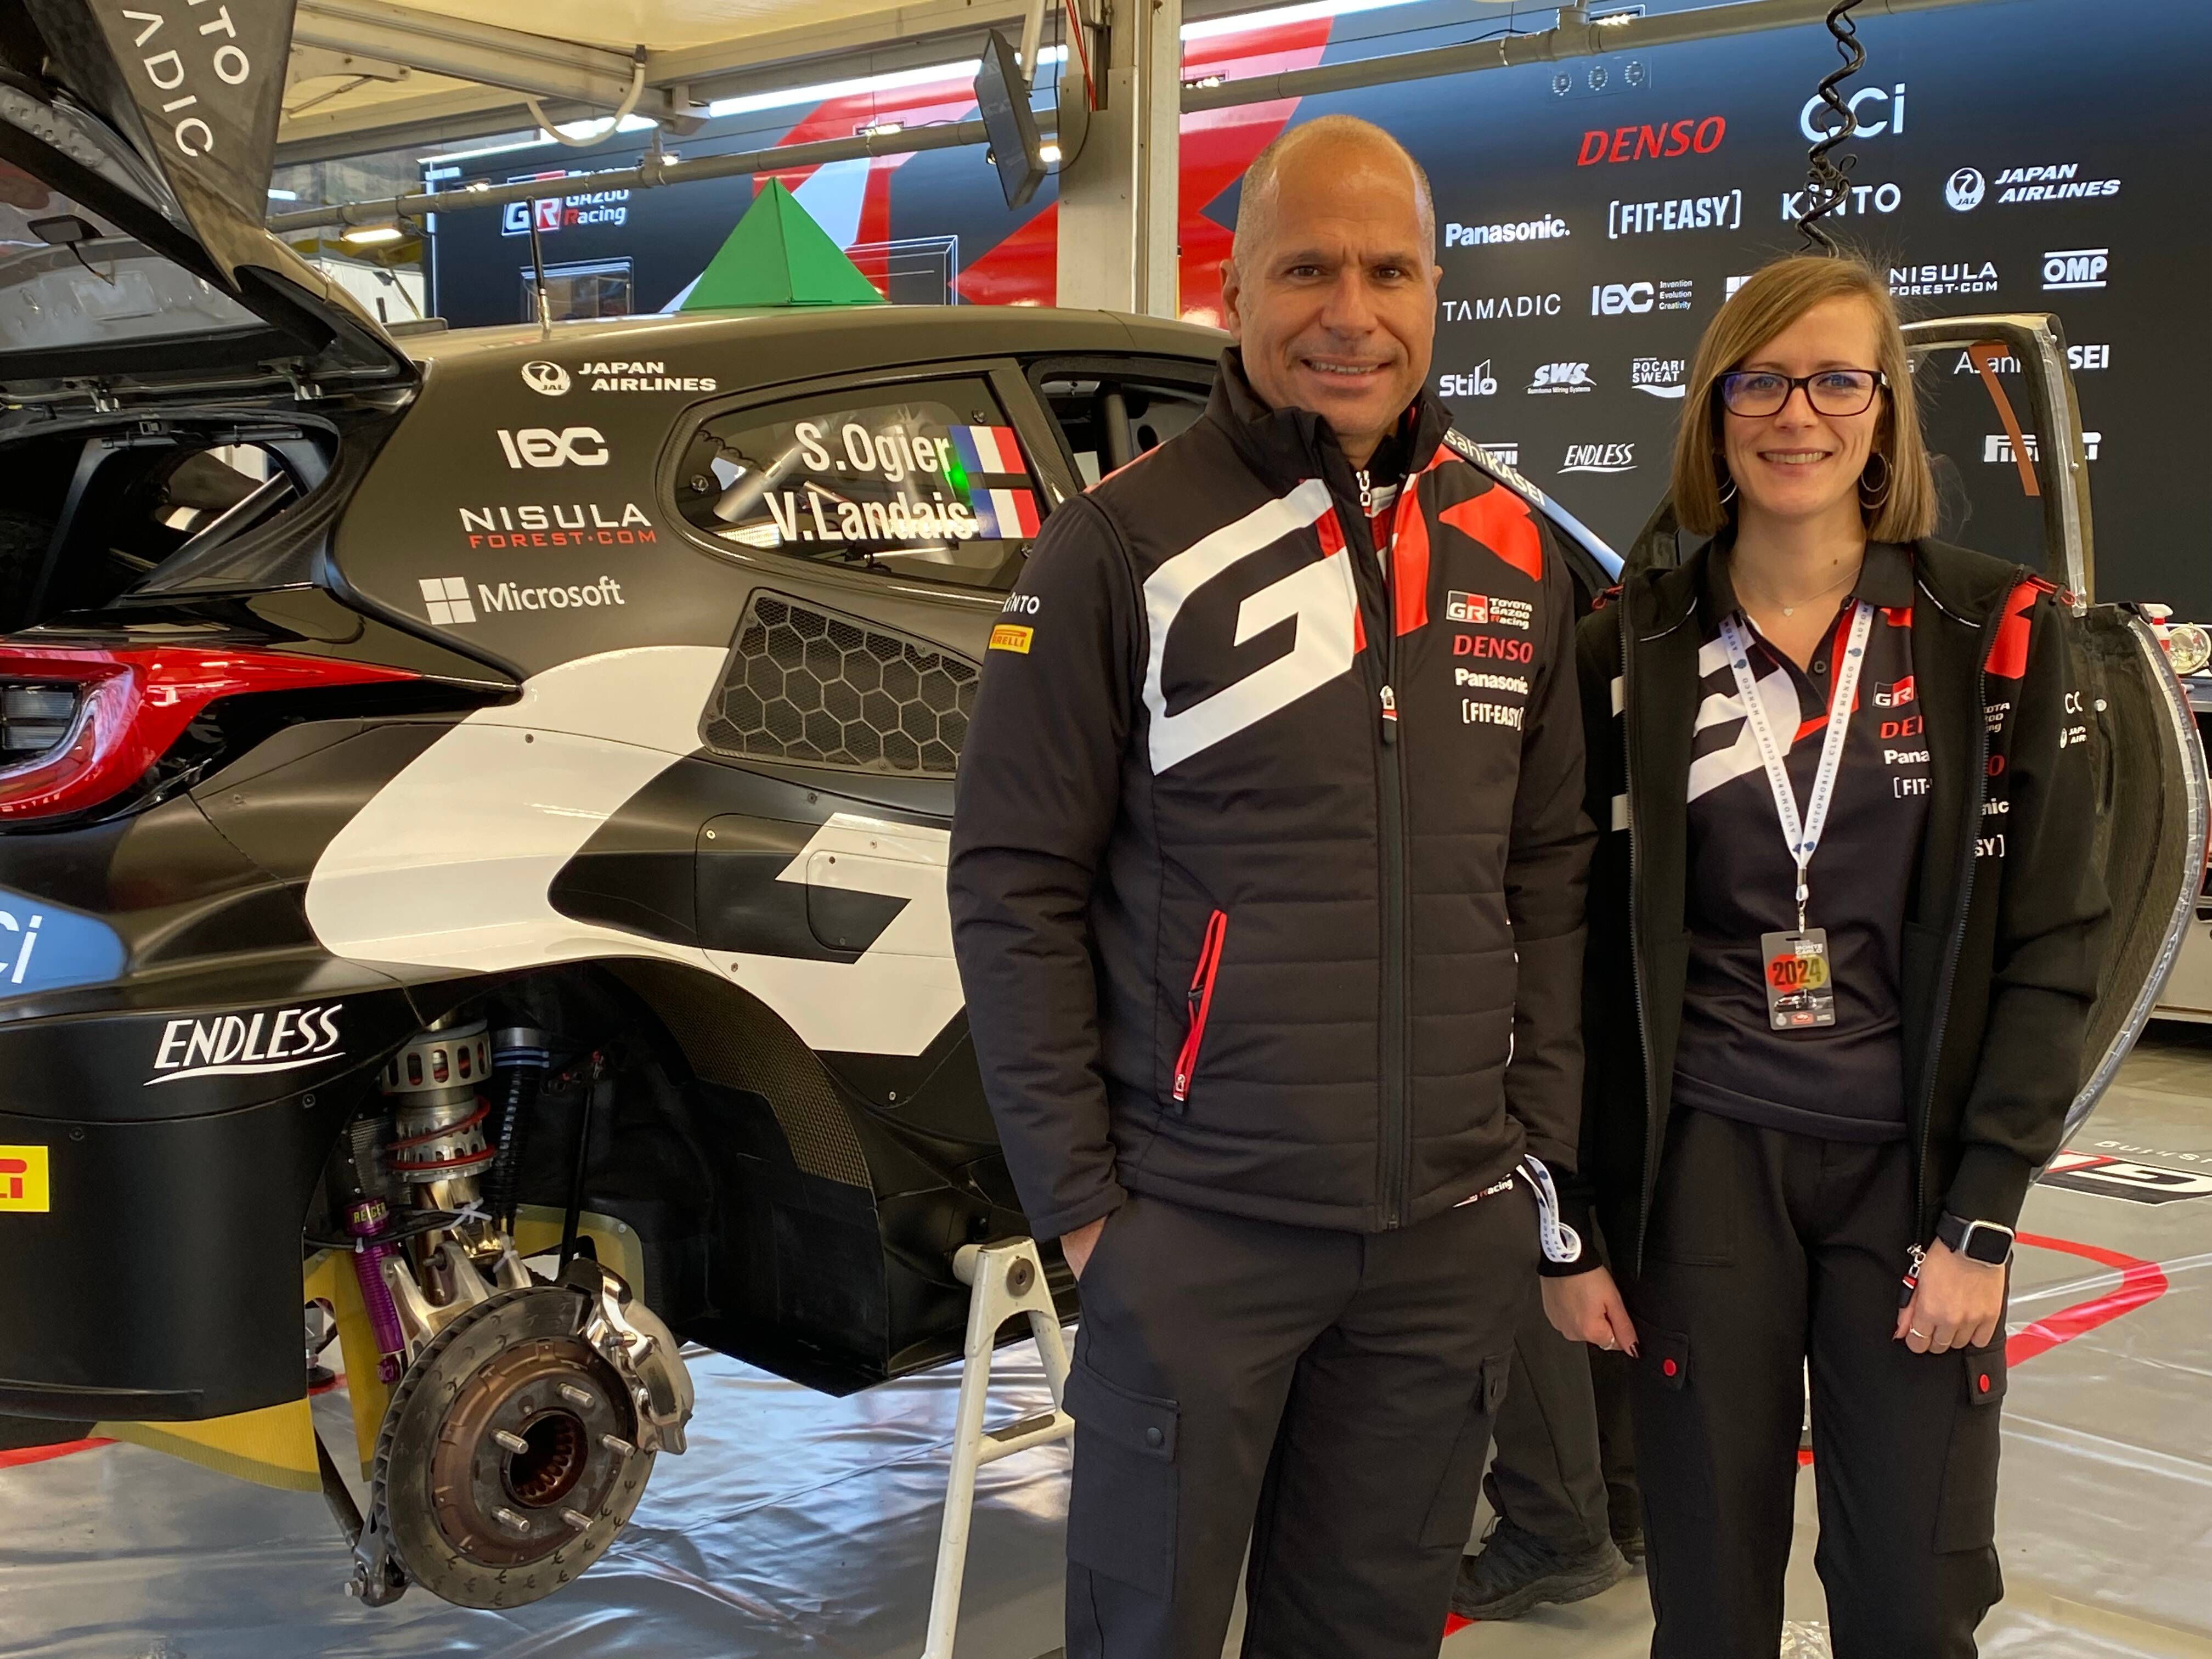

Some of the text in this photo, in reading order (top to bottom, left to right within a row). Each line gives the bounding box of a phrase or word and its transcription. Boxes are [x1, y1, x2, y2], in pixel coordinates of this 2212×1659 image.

[188, 0, 249, 84] TO
[1576, 116, 1726, 166] DENSO
[1995, 163, 2078, 184] JAPAN
[1998, 179, 2121, 204] AIRLINES
[563, 206, 628, 227] Racing
[1889, 262, 1997, 283] NISULA
[2043, 256, 2107, 281] OMP
[1659, 290, 1692, 300] Evolution
[1660, 280, 1692, 289] Invention
[1442, 294, 1561, 321] TAMADIC
[1659, 301, 1691, 311] Creativity
[579, 362, 664, 375] JAPAN
[1439, 359, 1497, 397] Stilo
[1532, 362, 1590, 387] SWS
[1632, 360, 1685, 373] POCARI
[1632, 371, 1680, 383] SWEAT
[591, 377, 716, 392] AIRLINES
[794, 422, 952, 482] S.Ogier
[1564, 443, 1635, 466] ENDLESS
[1444, 431, 1545, 506] sahiKASEI
[459, 504, 652, 532] NISULA
[763, 489, 975, 541] V.Landais
[478, 575, 625, 613] Microsoft
[1489, 597, 1533, 612] TOYOTA
[1449, 602, 1486, 622] GR
[1489, 606, 1530, 619] GAZOO
[1491, 614, 1530, 630] Racing
[1453, 634, 1533, 663] DENSO
[1742, 678, 1760, 716] MONACO
[1875, 686, 1912, 707] GR
[1811, 665, 1854, 831] AUTOMOBILE CLUB DE MONACO
[1773, 958, 1822, 986] 2024
[153, 1005, 343, 1069] ENDLESS
